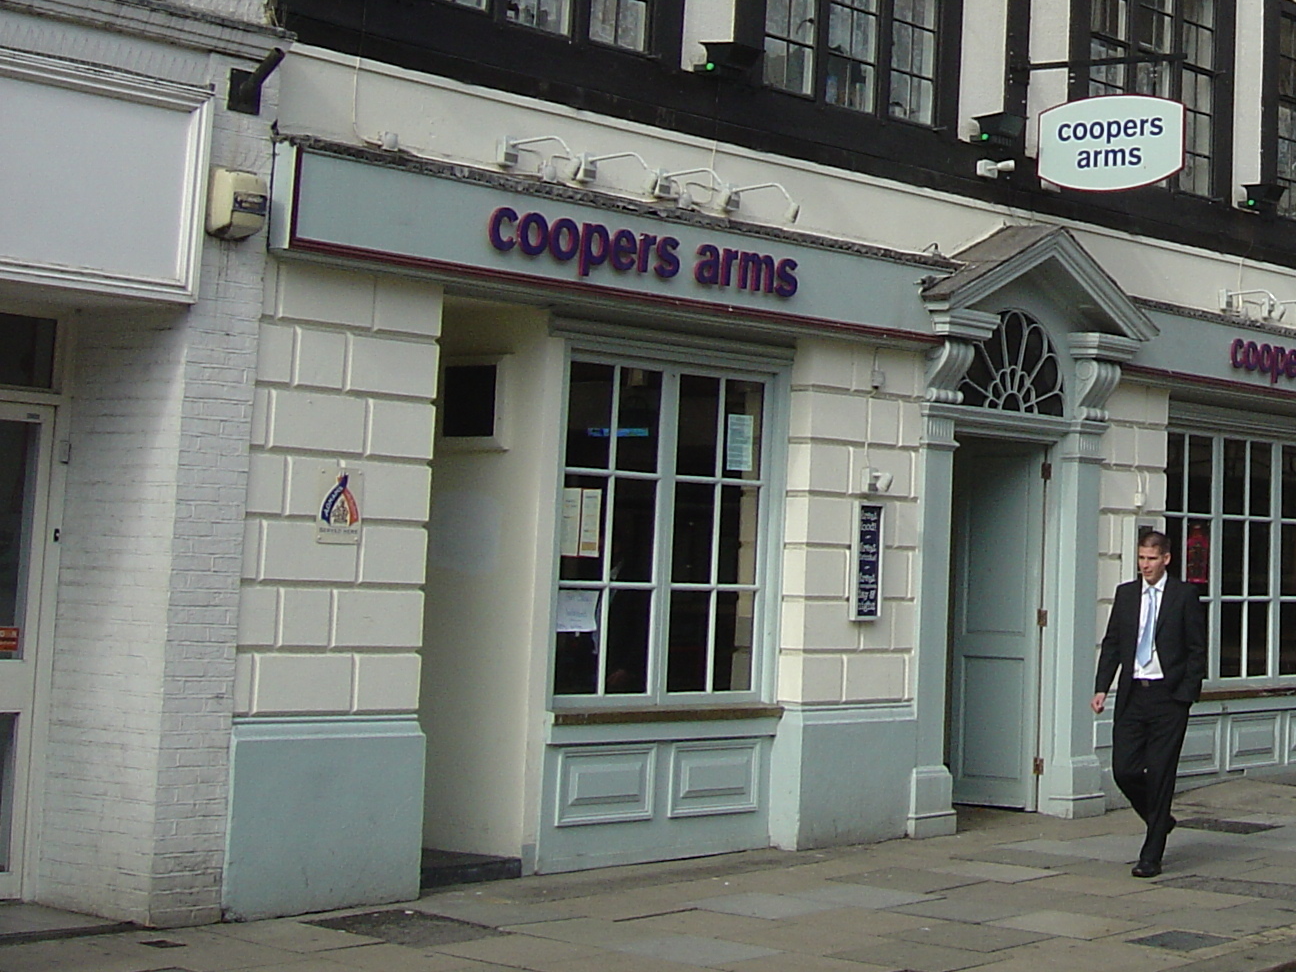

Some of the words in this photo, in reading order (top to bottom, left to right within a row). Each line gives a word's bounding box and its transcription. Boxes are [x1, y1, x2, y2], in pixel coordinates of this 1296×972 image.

[1057, 116, 1164, 144] coopers
[1076, 146, 1142, 169] arms
[488, 206, 681, 278] coopers
[693, 242, 799, 298] arms
